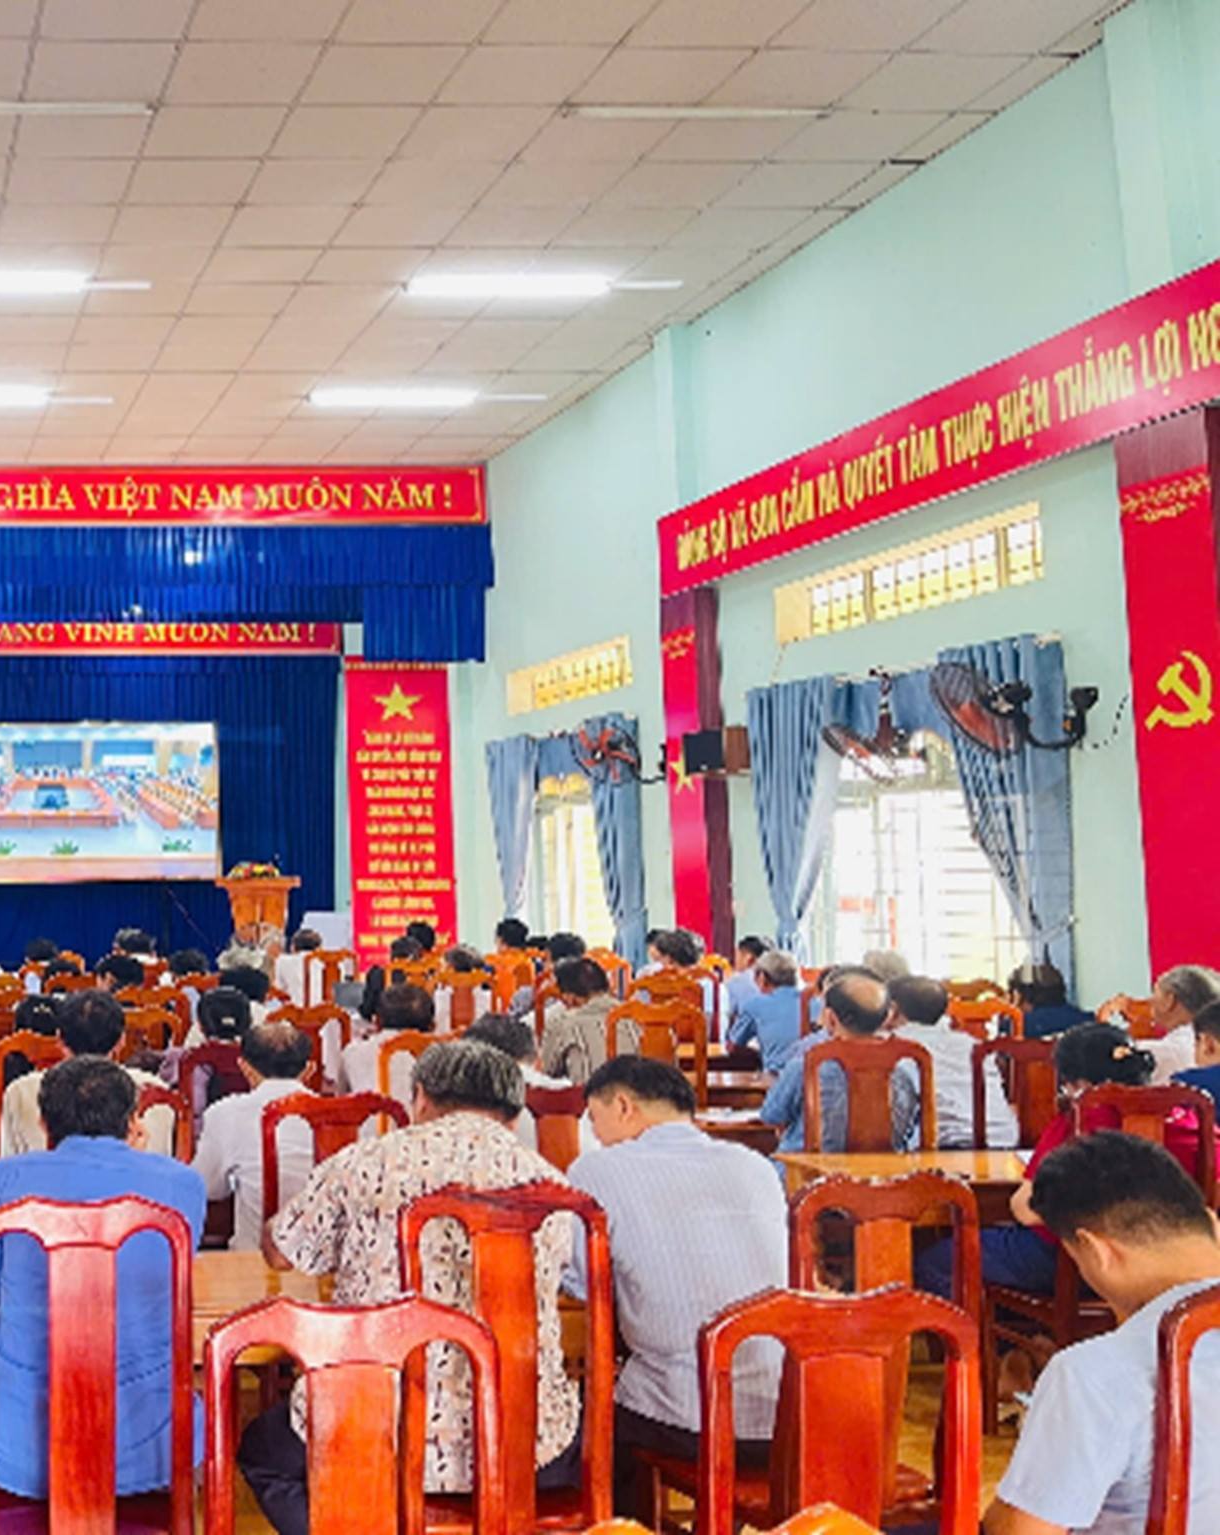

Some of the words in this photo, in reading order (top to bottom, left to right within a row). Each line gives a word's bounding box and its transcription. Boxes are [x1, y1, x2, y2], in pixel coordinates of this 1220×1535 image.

[81, 475, 162, 518] VIỆT
[169, 483, 245, 512] NAM
[251, 476, 352, 511] MUÔN
[361, 476, 436, 511] NĂM
